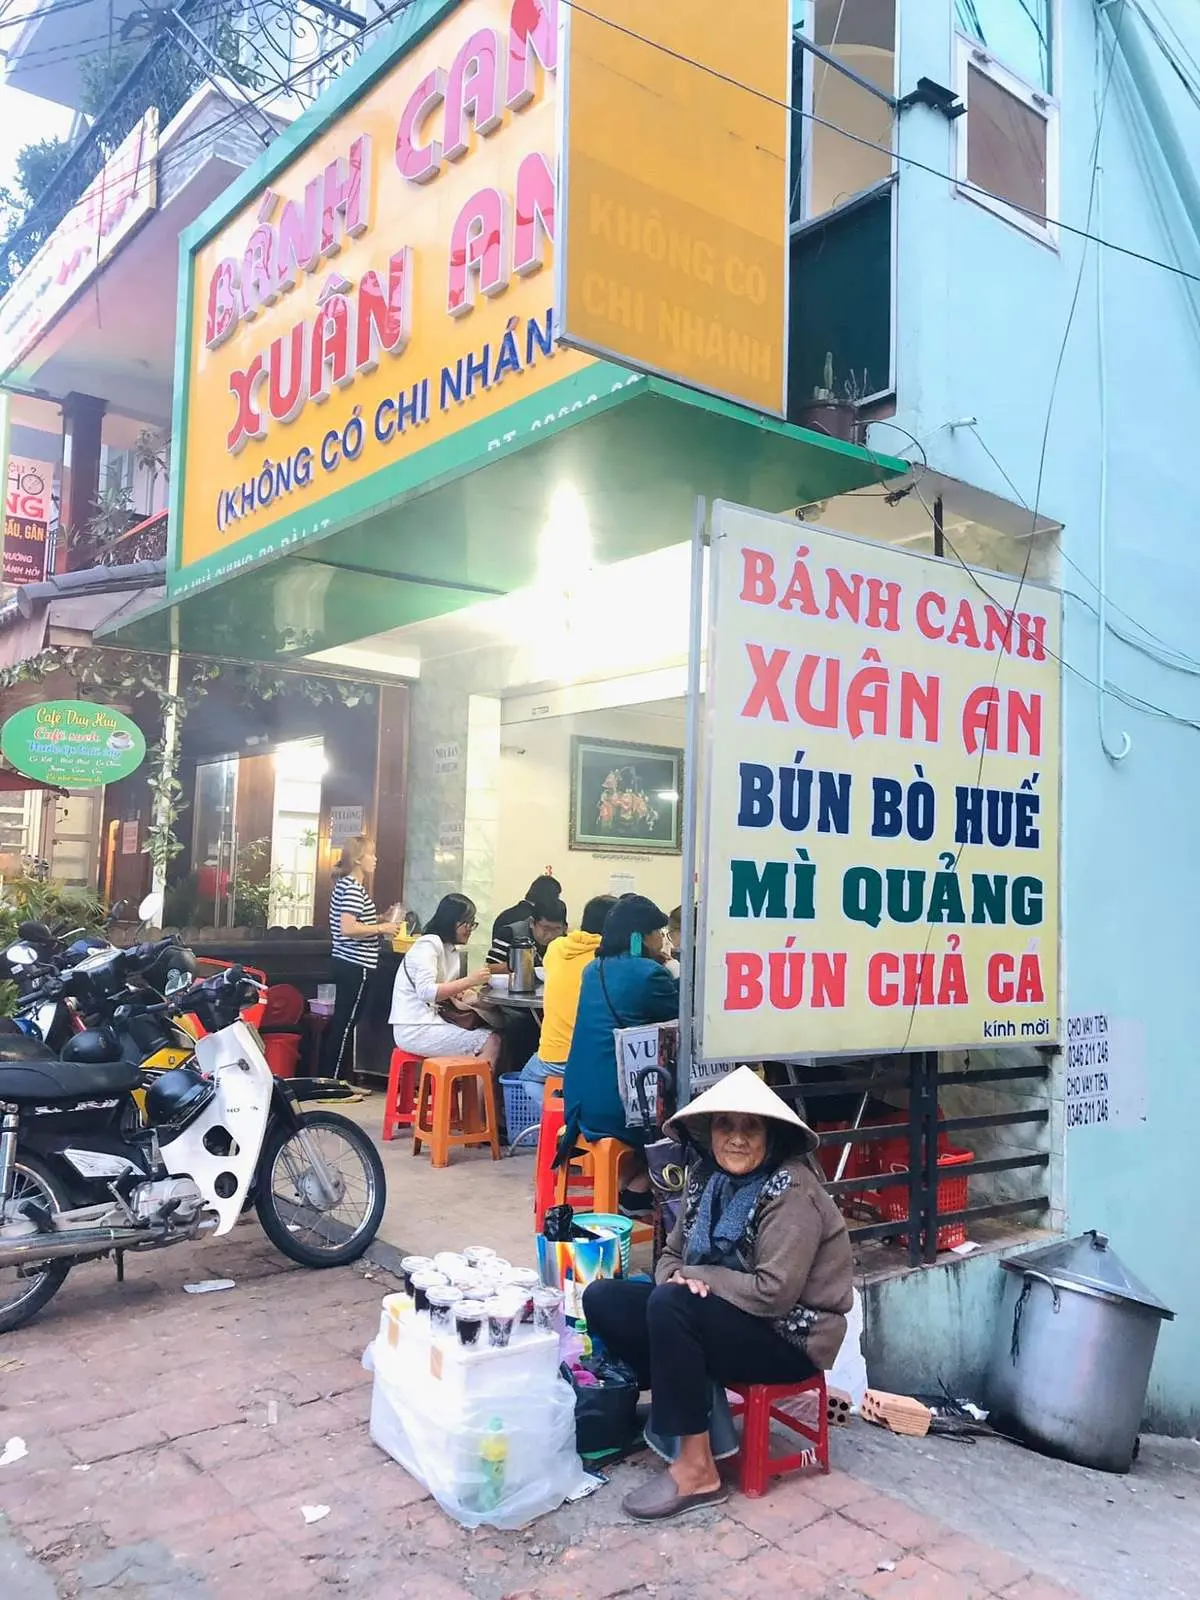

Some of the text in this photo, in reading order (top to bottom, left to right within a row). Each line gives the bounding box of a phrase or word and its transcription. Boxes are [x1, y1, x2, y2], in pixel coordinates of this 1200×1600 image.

[205, 133, 370, 350] BÁNH
[589, 193, 714, 286] KHÔNG
[227, 245, 413, 455] XUÂN
[581, 270, 771, 382] CHI NHÁNH
[217, 447, 313, 531] (KHÔNG
[321, 404, 365, 471] CÓ
[374, 379, 429, 443] CHI
[739, 546, 1047, 661] BÁNH CANH
[740, 643, 1041, 756] XUÂN AN
[737, 750, 1040, 849] BÚN BÒ HUẾ
[729, 848, 1044, 928] MÌ QUẢNG
[723, 936, 847, 1011] BÚN
[867, 933, 969, 1007] CHẢ
[983, 1017, 1050, 1038] kính mời
[1067, 1016, 1081, 1037] CHO
[1066, 1075, 1081, 1097] CHO
